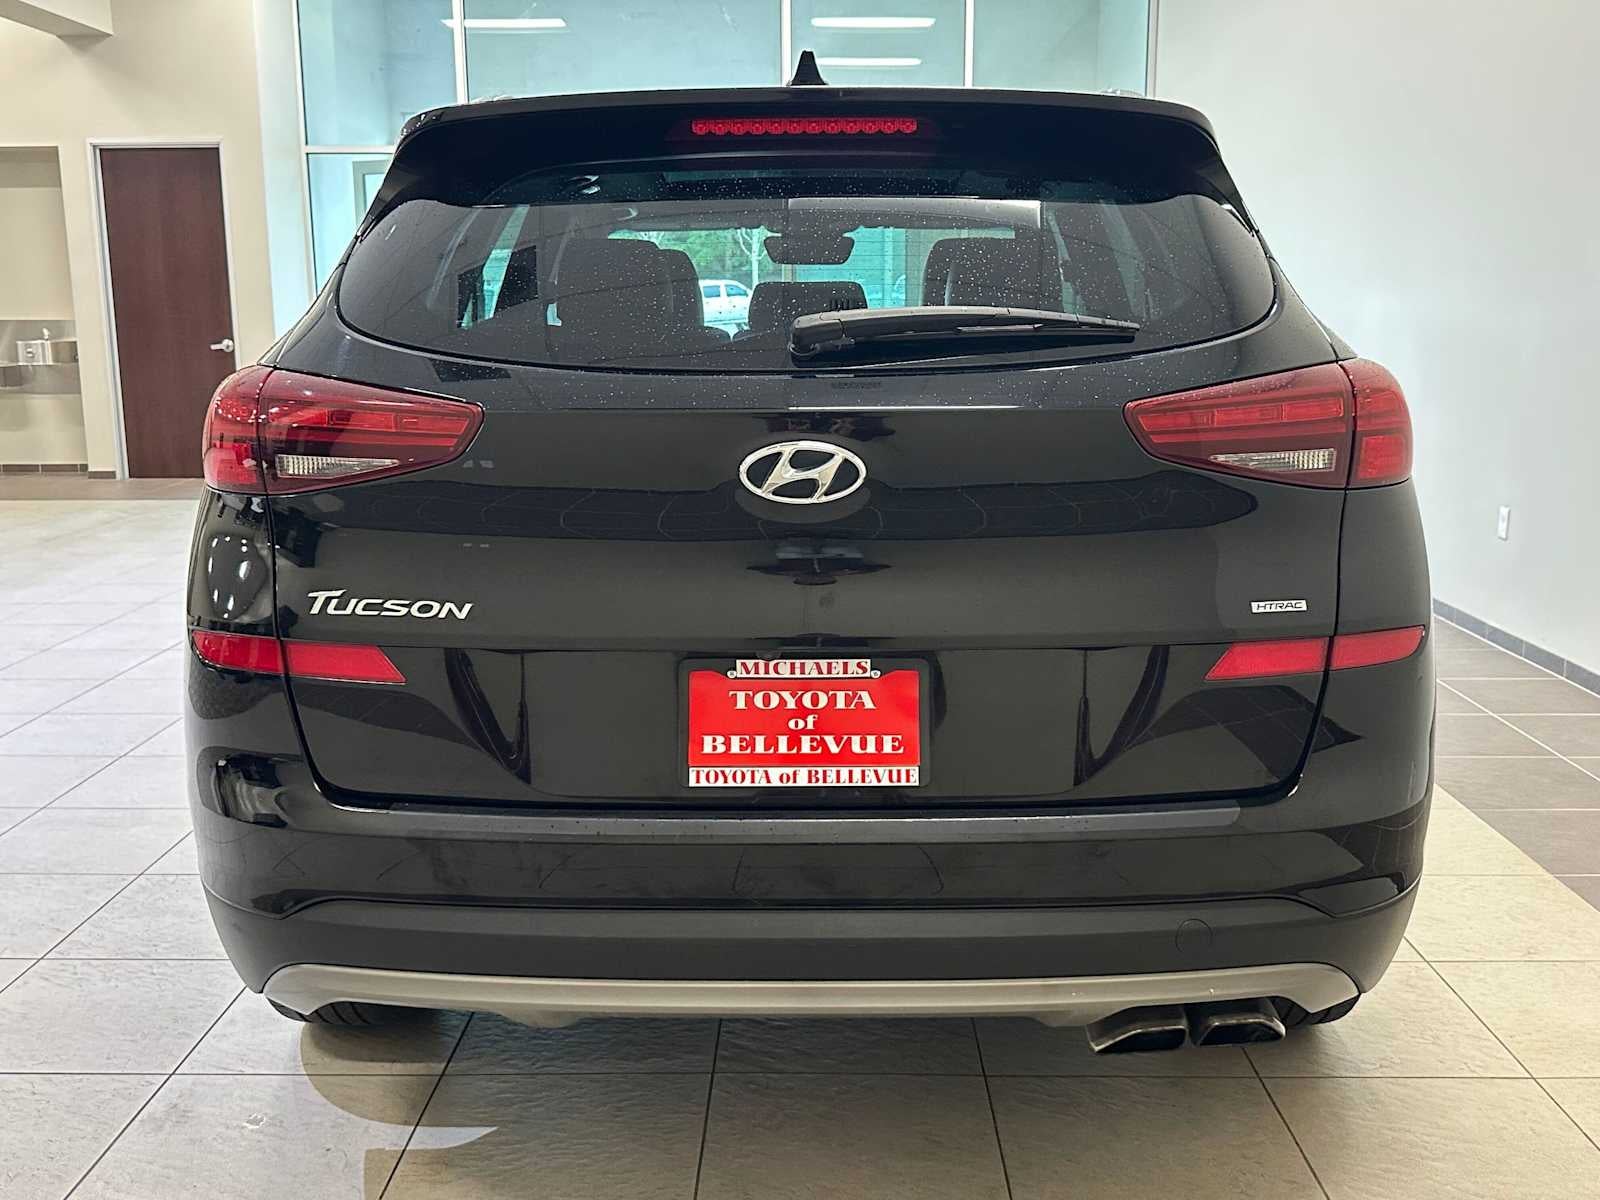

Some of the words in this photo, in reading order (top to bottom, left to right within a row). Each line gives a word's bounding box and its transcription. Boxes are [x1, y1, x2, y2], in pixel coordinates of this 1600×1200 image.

[307, 589, 474, 620] TUCSON
[1256, 601, 1304, 611] HTRAC
[739, 661, 869, 676] MICHAELS
[729, 690, 876, 710] TOYOTA
[788, 714, 818, 730] of
[701, 735, 904, 754] BELLEVUE
[691, 769, 772, 784] TOYOTA
[779, 770, 800, 784] of
[807, 769, 917, 784] BELLEVUE
